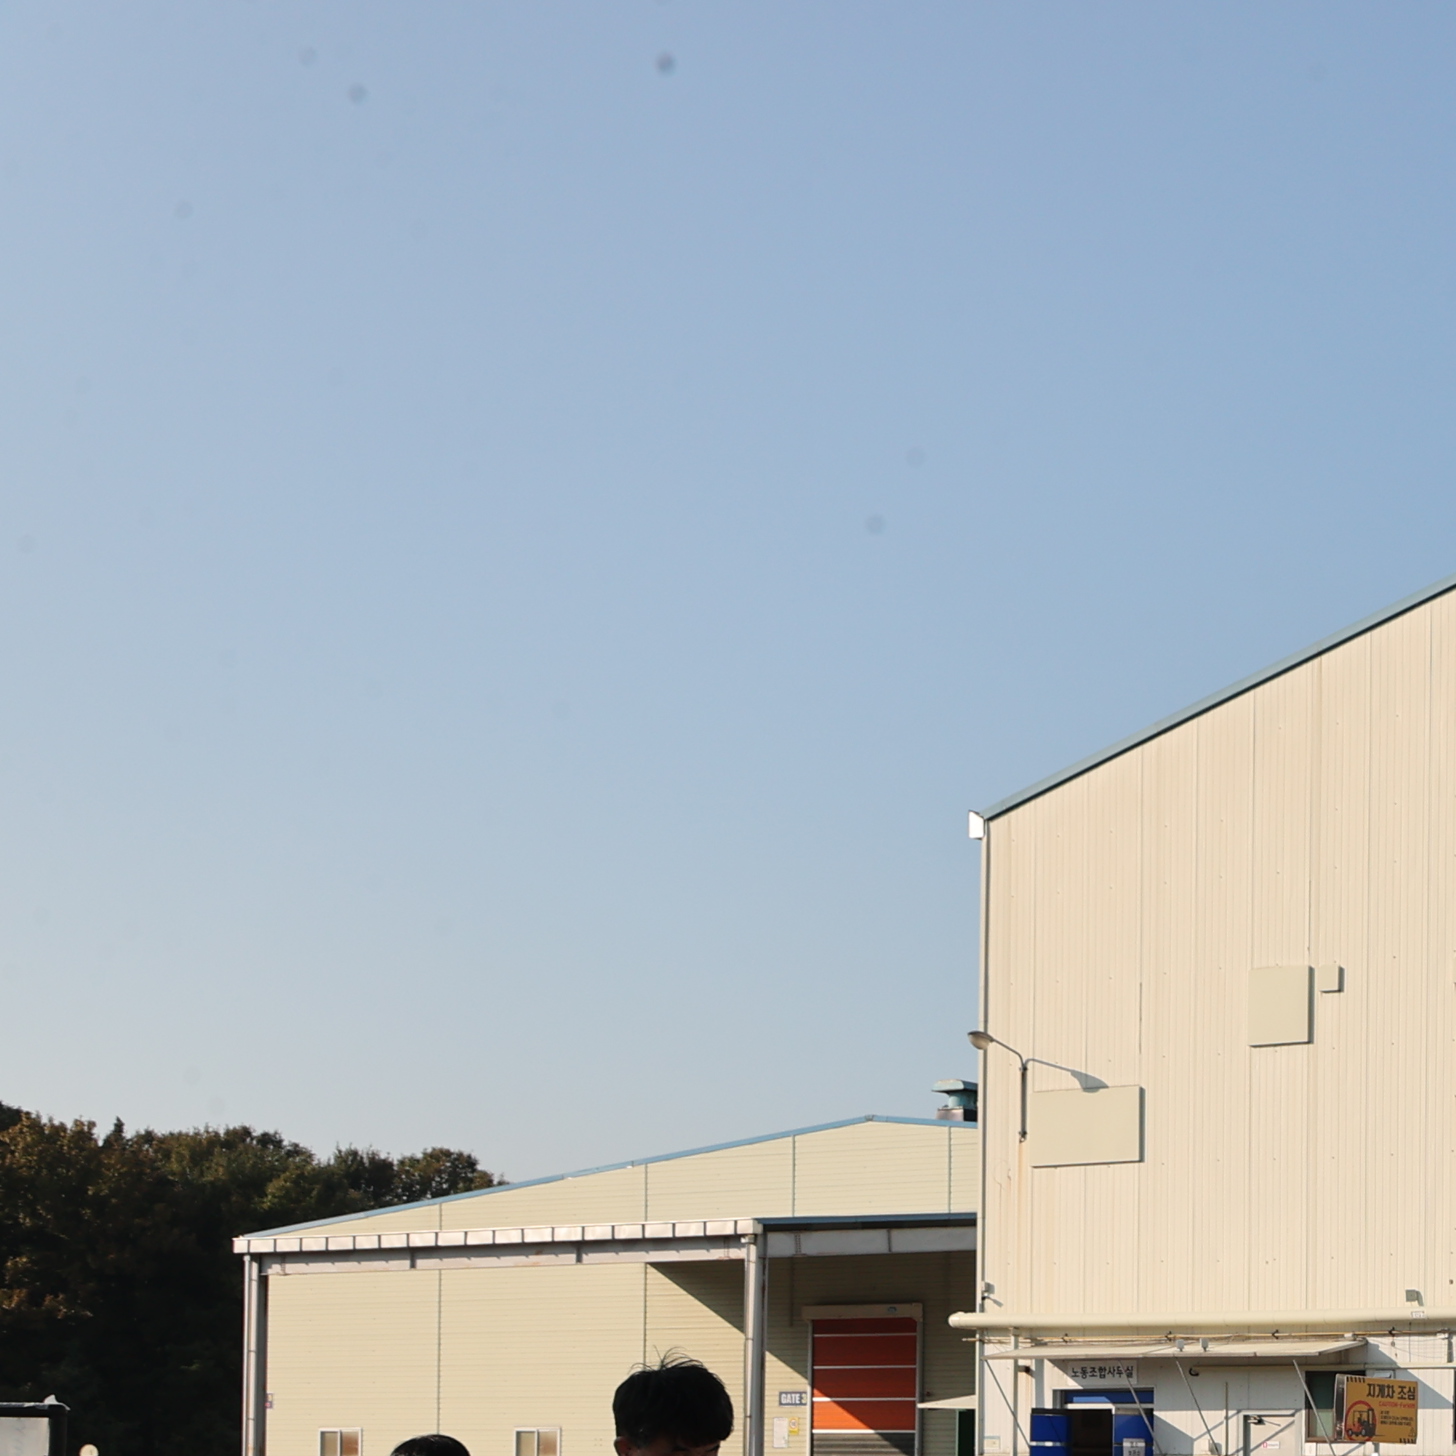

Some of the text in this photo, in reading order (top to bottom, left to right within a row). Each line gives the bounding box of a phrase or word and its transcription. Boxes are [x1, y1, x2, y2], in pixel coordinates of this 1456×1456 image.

[781, 1393, 800, 1404] GATE
[1366, 1383, 1416, 1400] 지게차 조심
